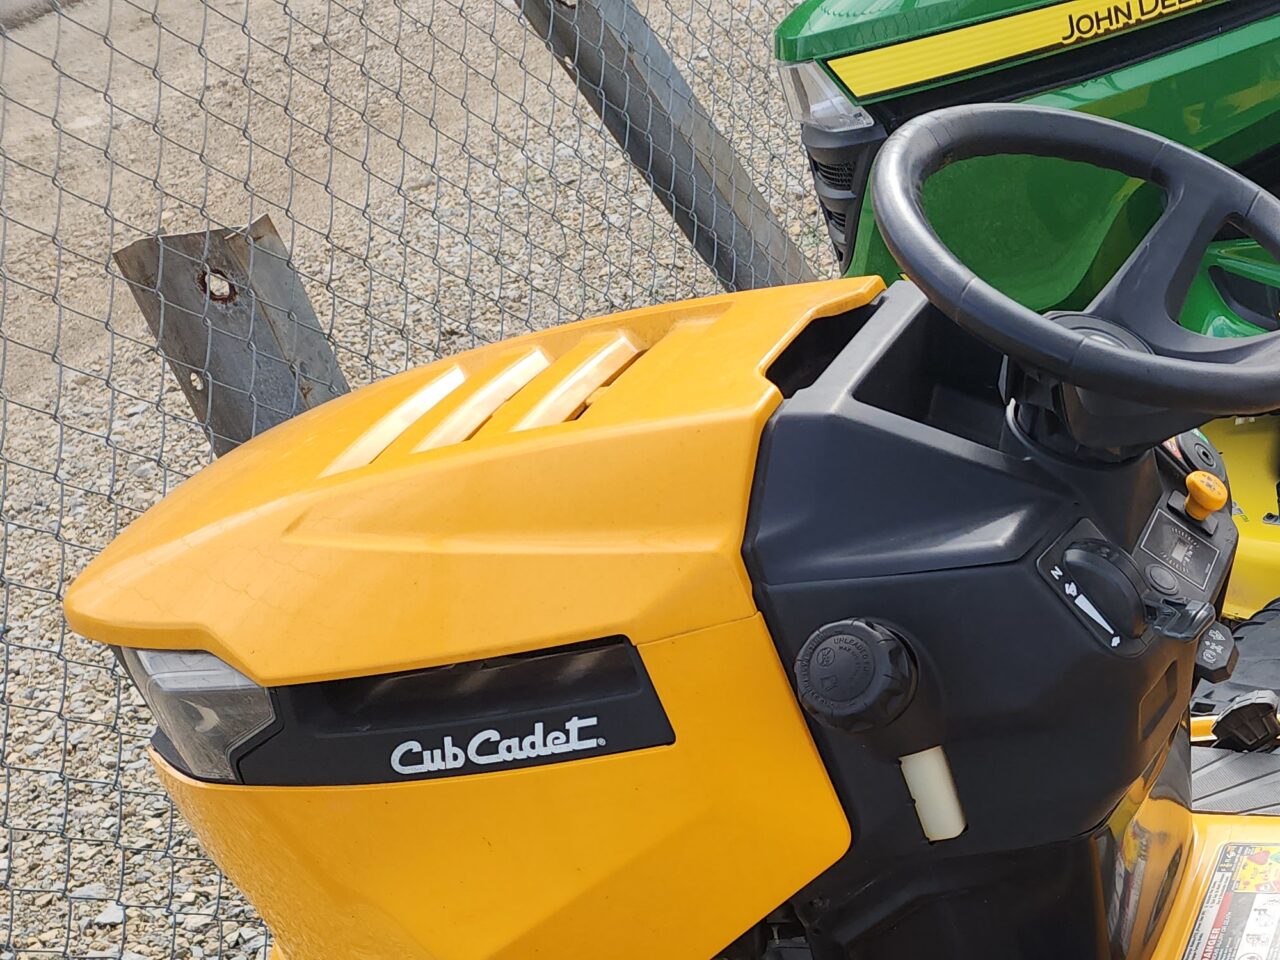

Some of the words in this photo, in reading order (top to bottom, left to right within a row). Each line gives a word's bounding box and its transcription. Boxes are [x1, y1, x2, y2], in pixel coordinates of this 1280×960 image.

[1062, 2, 1133, 40] JOHN
[390, 735, 465, 775] Cub
[467, 716, 598, 764] Cadet
